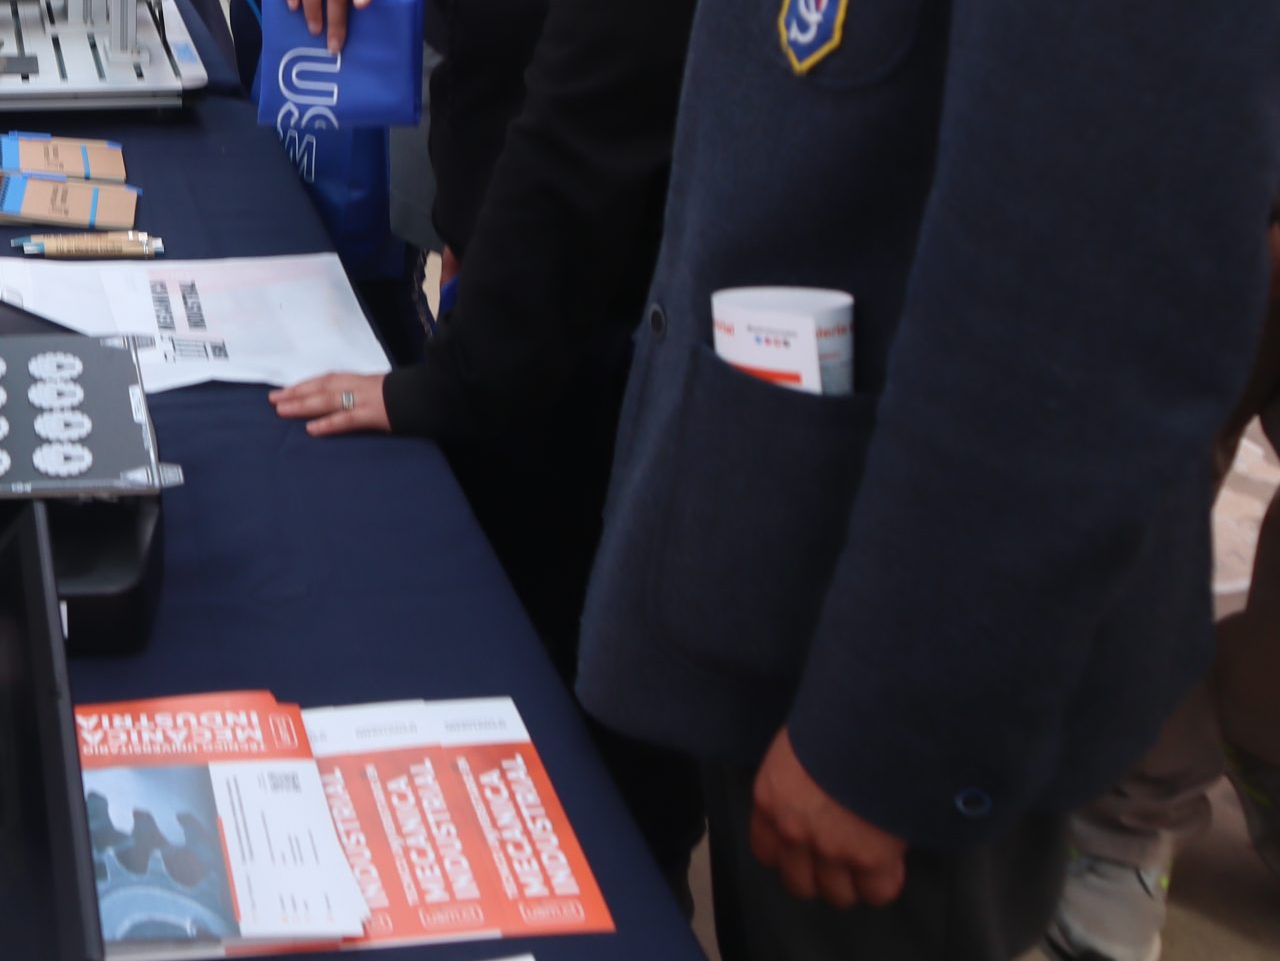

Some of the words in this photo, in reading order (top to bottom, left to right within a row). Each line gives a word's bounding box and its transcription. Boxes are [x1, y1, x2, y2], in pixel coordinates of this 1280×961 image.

[75, 709, 261, 731] INDUSTRIA
[410, 756, 480, 901] INDUSTRIAL
[501, 751, 581, 896] INDUSTRIAL
